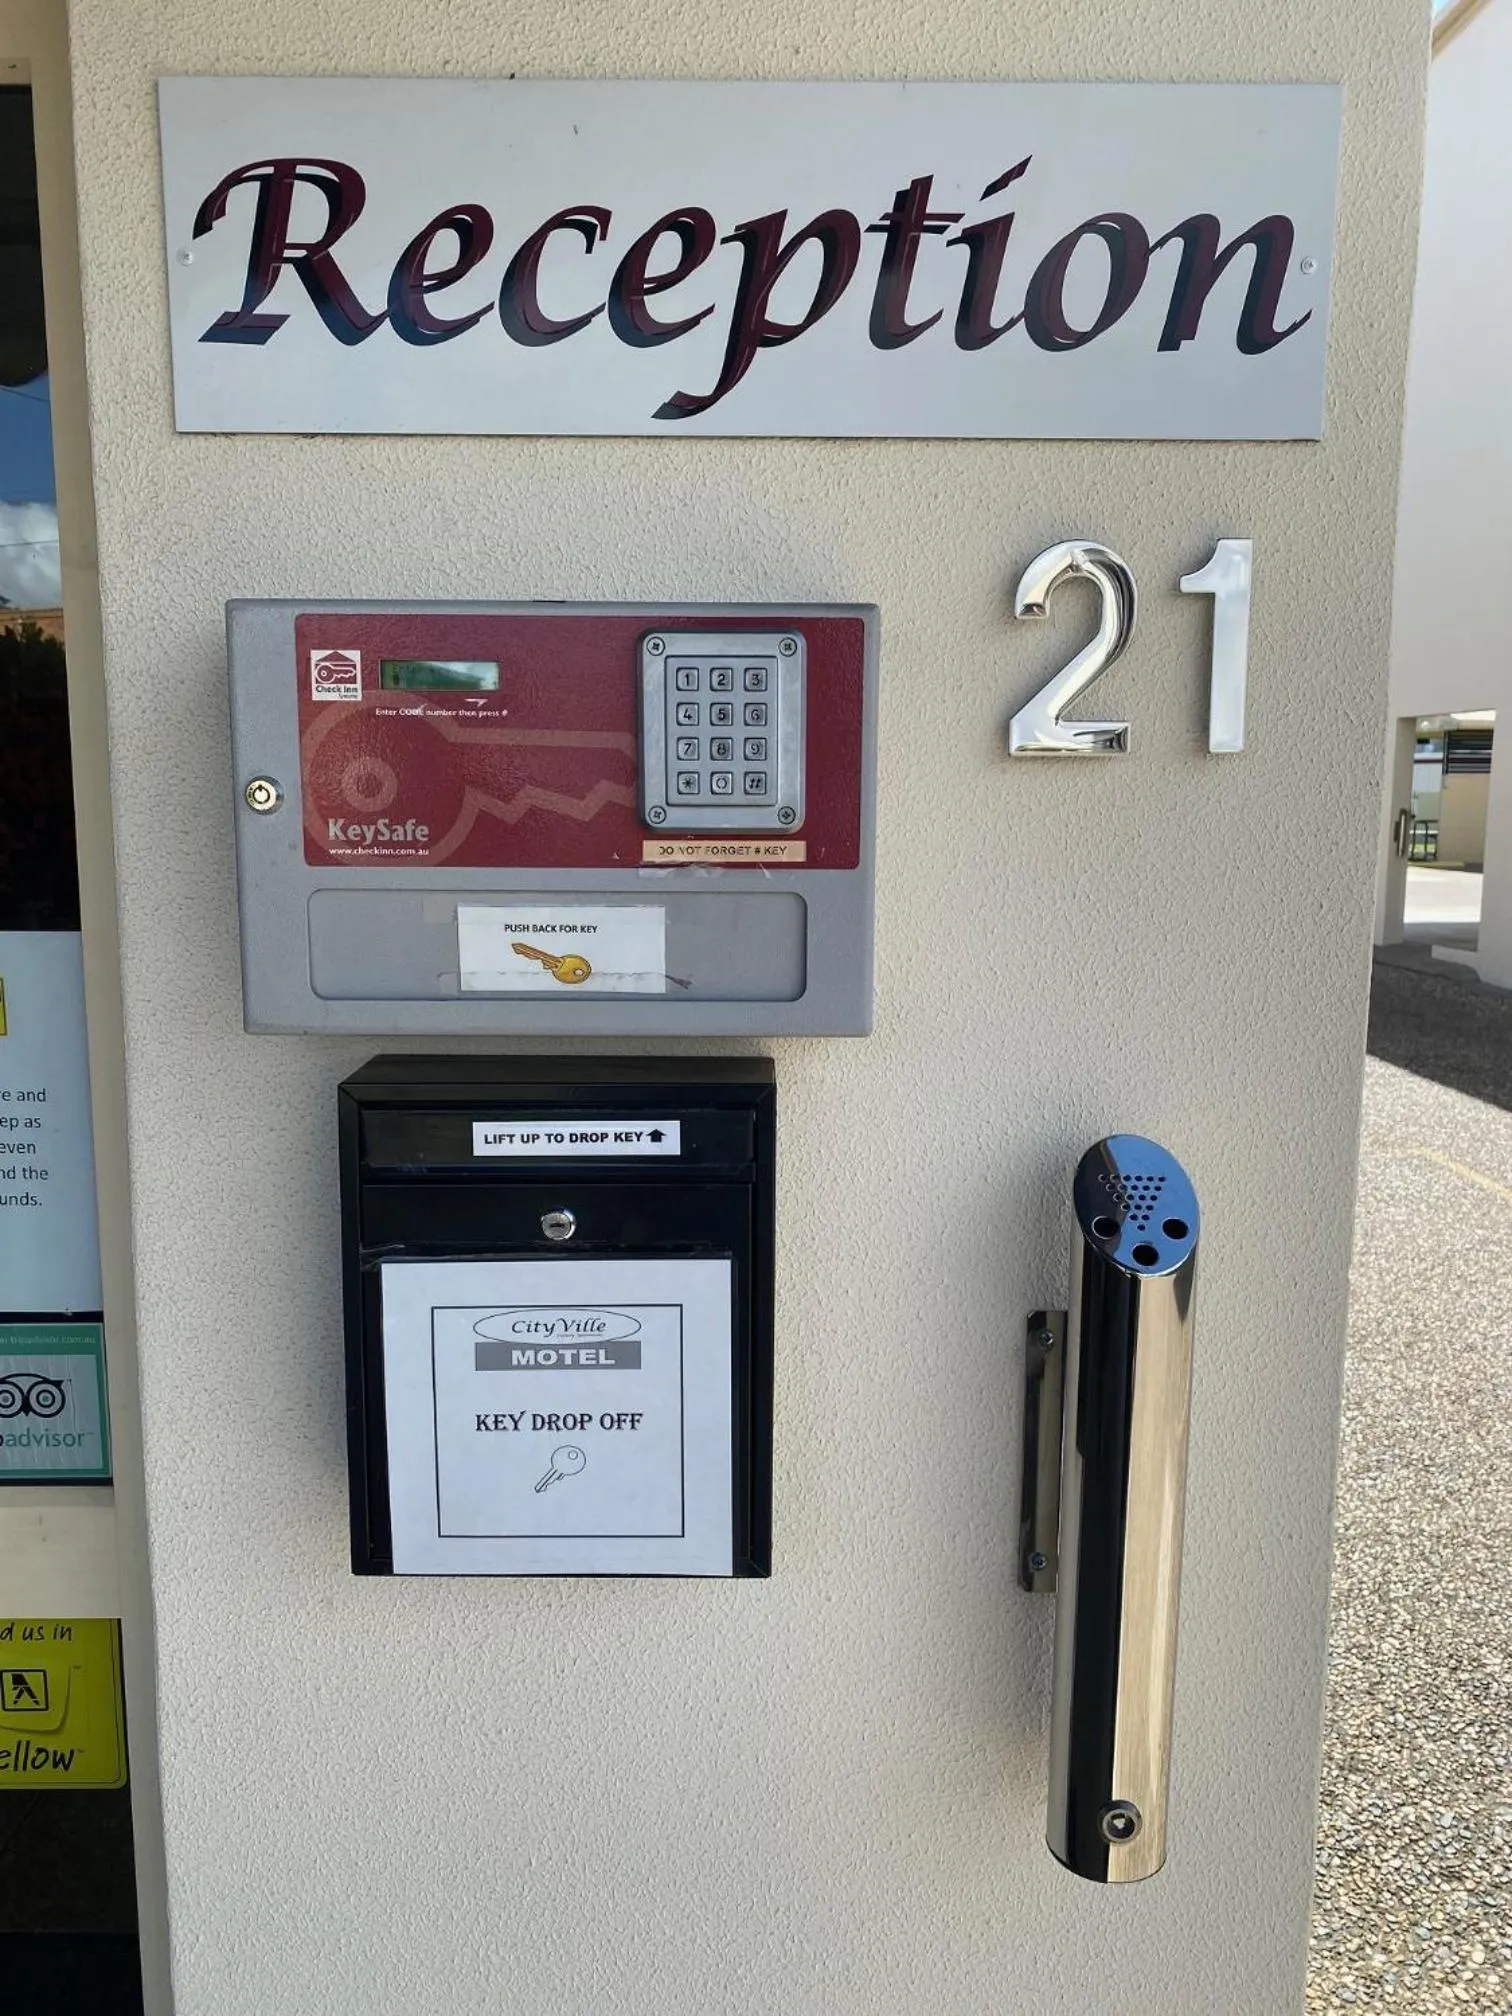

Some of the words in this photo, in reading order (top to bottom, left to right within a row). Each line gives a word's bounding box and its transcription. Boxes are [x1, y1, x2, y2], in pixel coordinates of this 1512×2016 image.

[192, 154, 1313, 420] Reception
[1008, 537, 1254, 759] 21
[716, 673, 727, 687] 2
[751, 673, 761, 687] 3
[375, 707, 397, 716] Enter
[426, 707, 458, 716] number
[459, 707, 477, 716] then
[478, 708, 500, 718] press
[683, 709, 692, 722] 4
[717, 708, 727, 721] 5
[750, 708, 760, 721] 6
[683, 743, 692, 756] 7
[717, 742, 727, 756] 8
[750, 742, 760, 756] 9
[327, 817, 430, 846] KeySafe
[328, 846, 430, 856] www.checkinn.com.au
[704, 846, 751, 856] FORGET
[764, 846, 788, 856] KEY
[504, 923, 530, 933] PUSH
[532, 923, 557, 933] BACK
[559, 924, 578, 933] FOR
[580, 924, 598, 934] KEY
[16, 1088, 47, 1102] and
[24, 1116, 42, 1129] as
[484, 1133, 516, 1145] LIFT
[520, 1133, 540, 1144] UP
[545, 1133, 565, 1144] TO
[569, 1132, 609, 1144] DROP
[613, 1131, 644, 1143] KEY
[22, 1166, 49, 1180] the
[511, 1317, 607, 1338] CityVille
[511, 1349, 616, 1366] MOTEL
[475, 1410, 528, 1432] KEY
[531, 1413, 593, 1433] DROP
[599, 1412, 644, 1431] OFF
[22, 1624, 46, 1642] us
[53, 1623, 73, 1642] in
